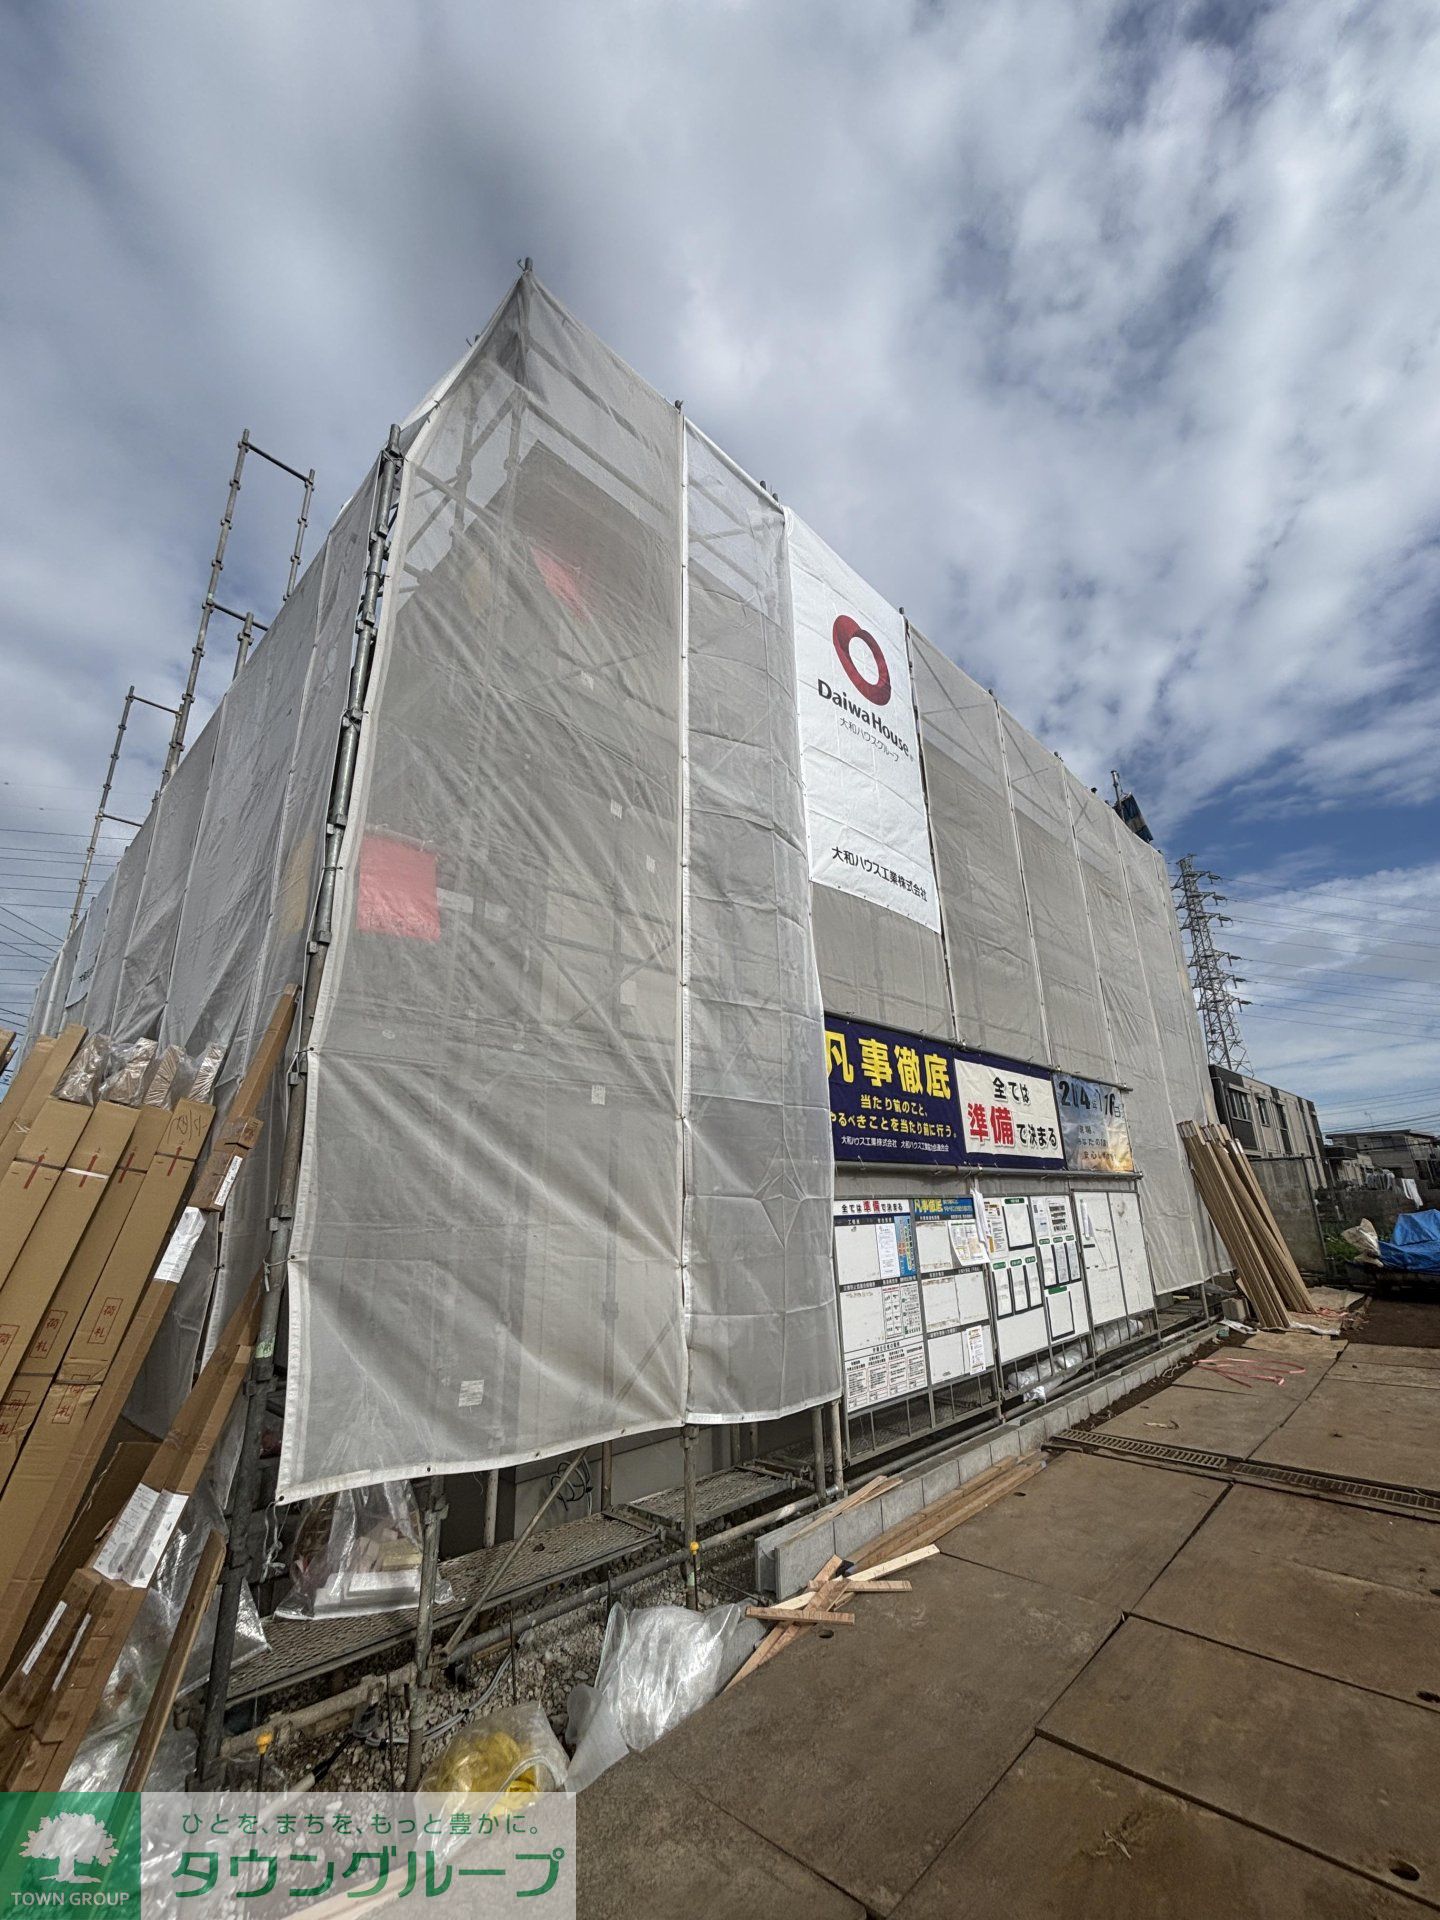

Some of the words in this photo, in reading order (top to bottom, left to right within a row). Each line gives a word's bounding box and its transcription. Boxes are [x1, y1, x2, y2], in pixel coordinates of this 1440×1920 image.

[832, 846, 928, 902] 大和ハウス工業株式会社
[826, 1030, 952, 1100] 凡事徹底
[860, 1094, 928, 1117] 当たり前のこと、
[992, 1076, 1030, 1104] 全ては
[967, 1102, 1058, 1147] 準備で決まる
